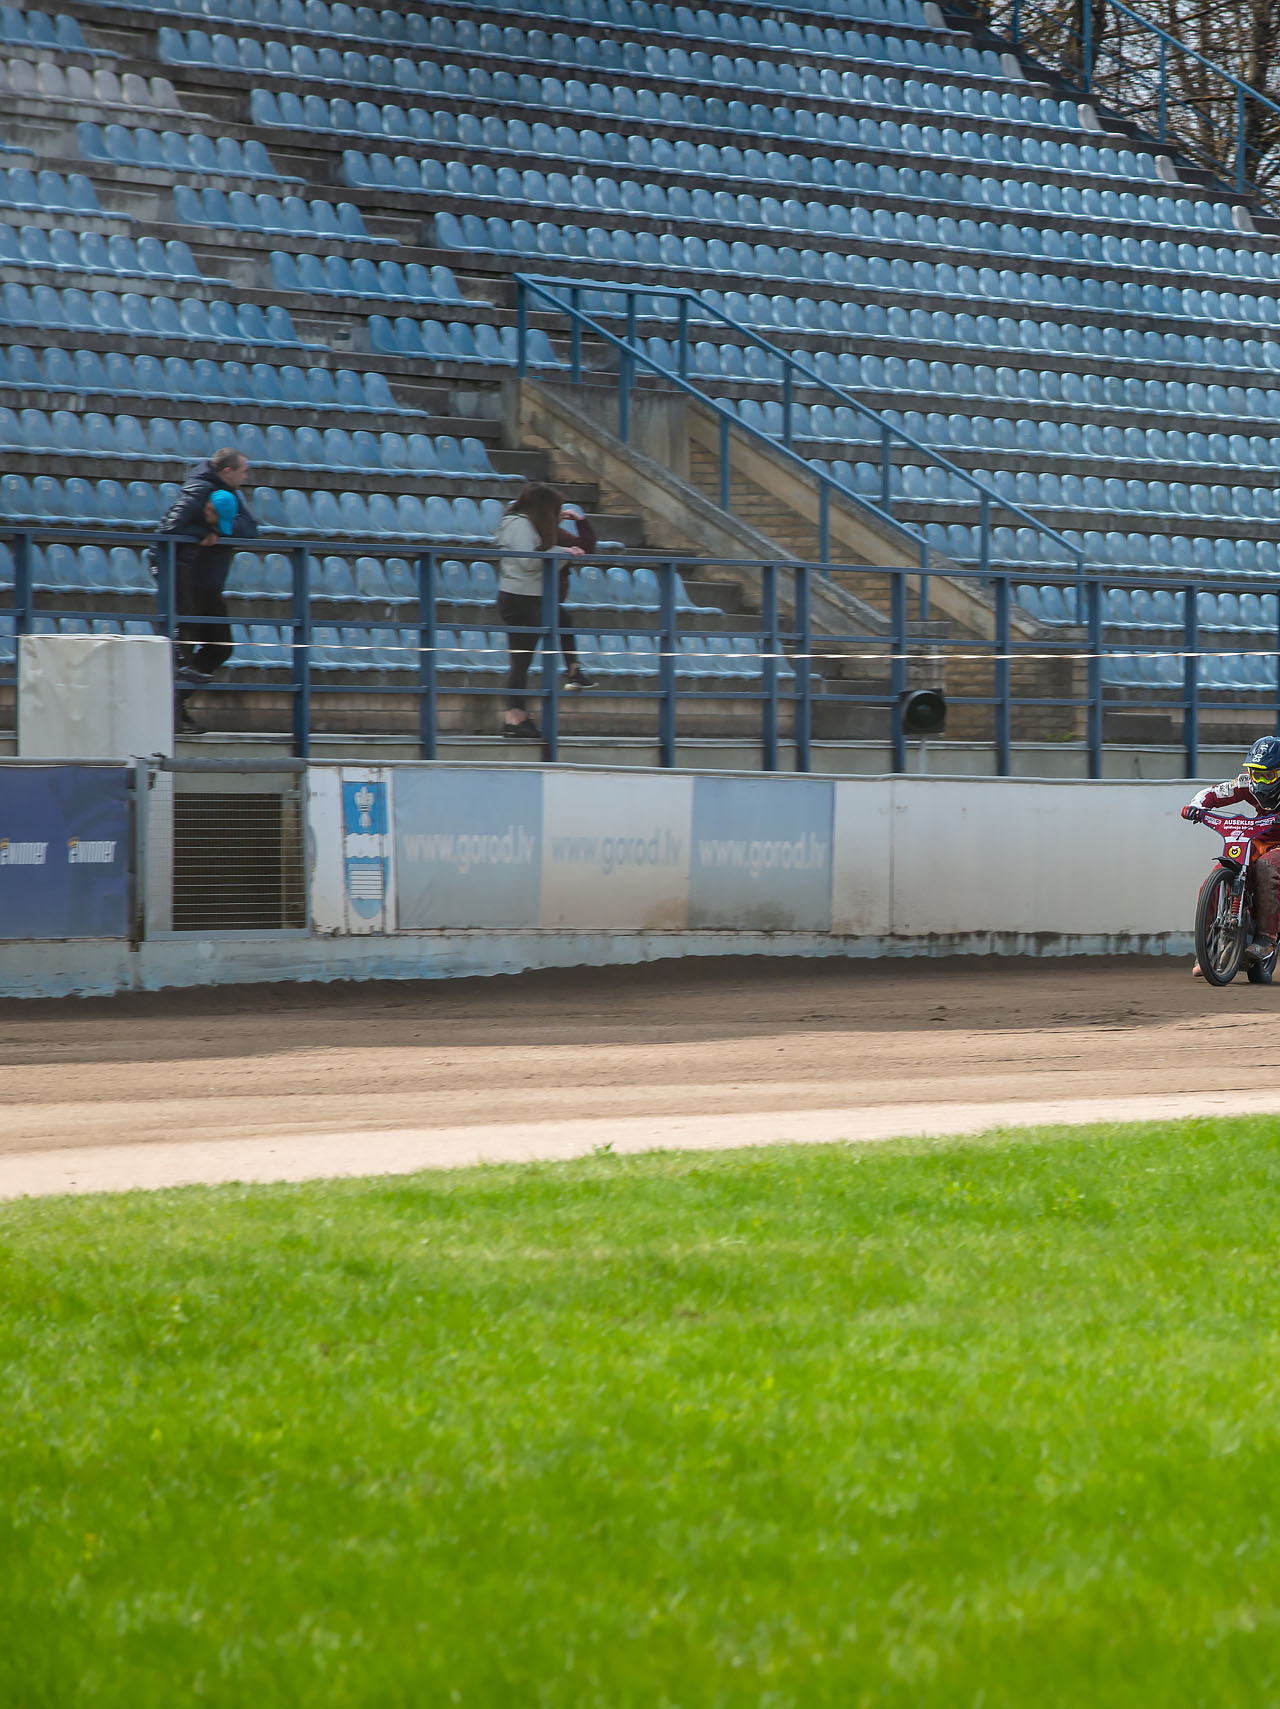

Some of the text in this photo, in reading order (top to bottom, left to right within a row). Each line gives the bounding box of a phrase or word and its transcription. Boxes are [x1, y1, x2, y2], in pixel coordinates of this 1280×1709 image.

[402, 824, 535, 874] www.gorod.lv
[551, 828, 682, 874] www.gorod.lv
[698, 831, 827, 878] www.gorod.lv
